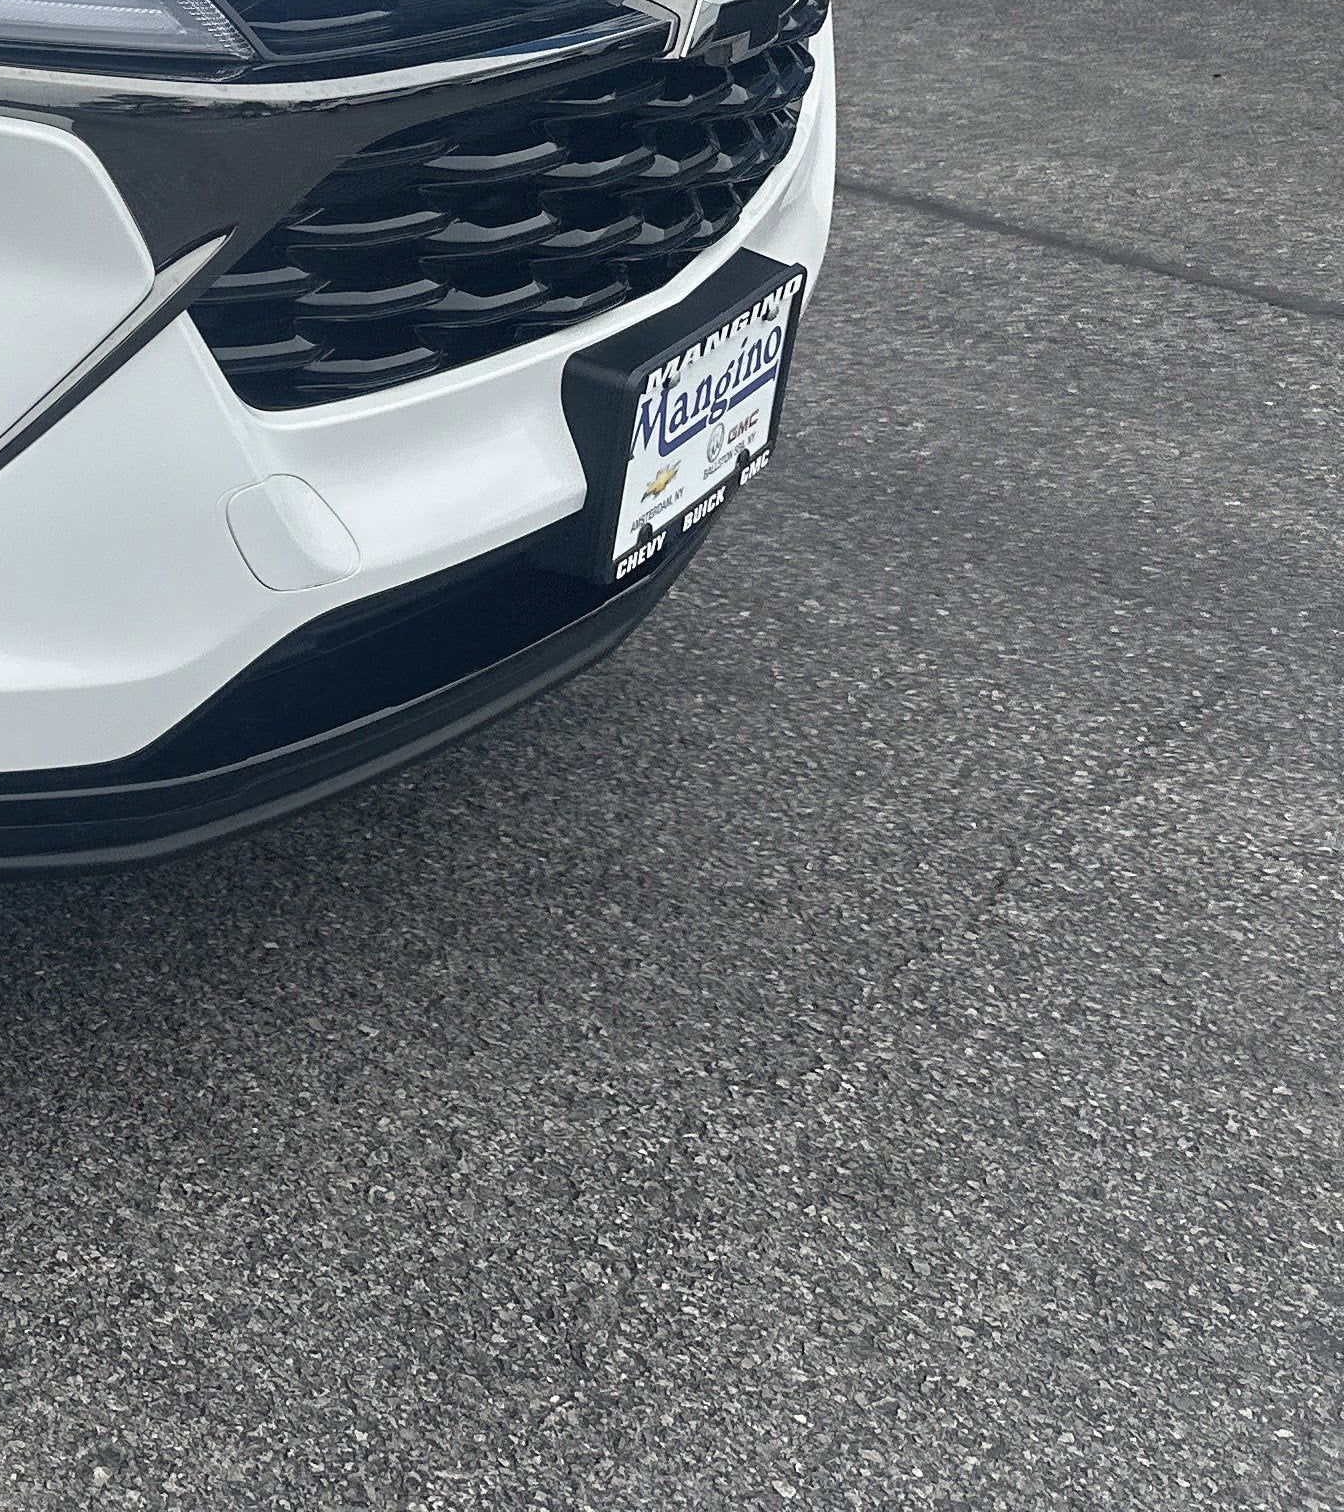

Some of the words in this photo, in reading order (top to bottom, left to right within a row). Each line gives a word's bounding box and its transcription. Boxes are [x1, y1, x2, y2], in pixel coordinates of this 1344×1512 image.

[629, 324, 782, 457] Mangino
[645, 273, 804, 396] MANGINO
[727, 408, 760, 445] GMC
[615, 530, 667, 580] CHEVY
[682, 485, 727, 532] BUICK
[739, 448, 771, 486] GMC
